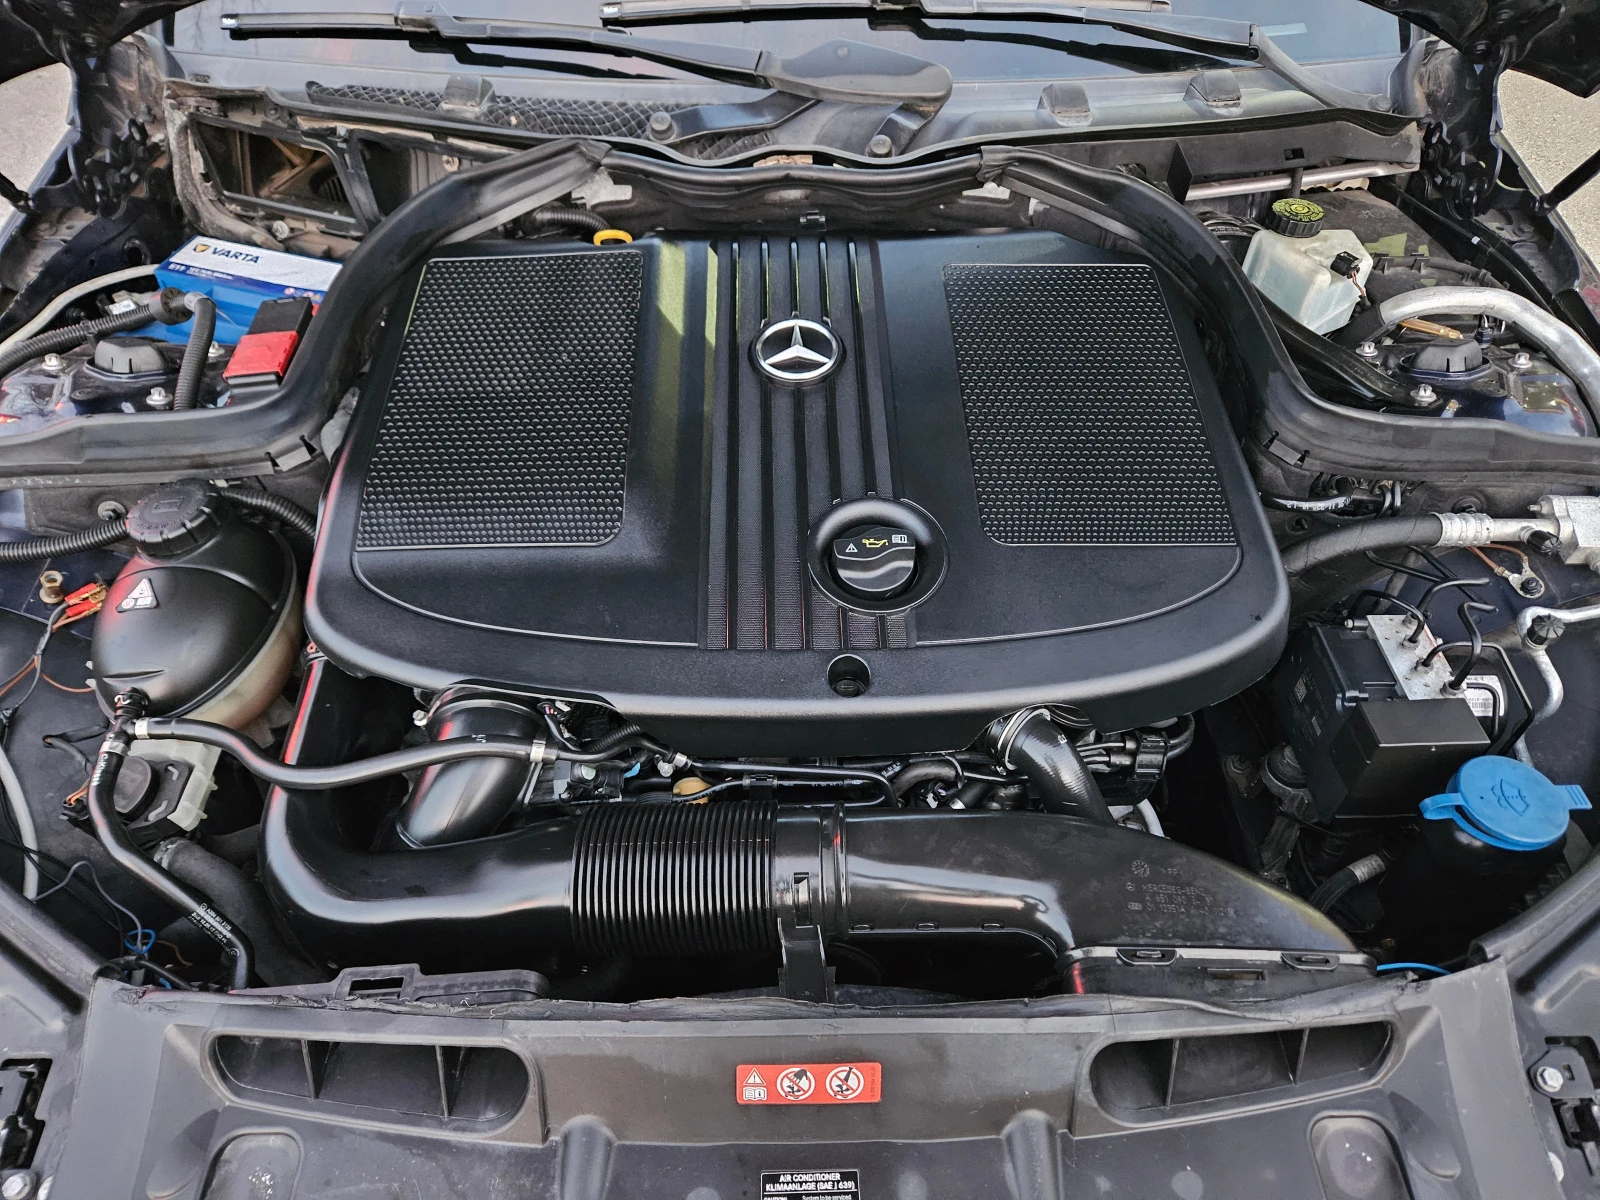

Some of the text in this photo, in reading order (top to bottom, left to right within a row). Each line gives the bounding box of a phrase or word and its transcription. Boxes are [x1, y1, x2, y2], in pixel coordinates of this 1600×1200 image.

[211, 247, 261, 264] VARTA
[779, 1172, 841, 1182] AIR CONDITIONER
[765, 1182, 817, 1191] KLIMAANLAGE
[817, 1181, 833, 1190] (SAE
[838, 1180, 855, 1190] 639)
